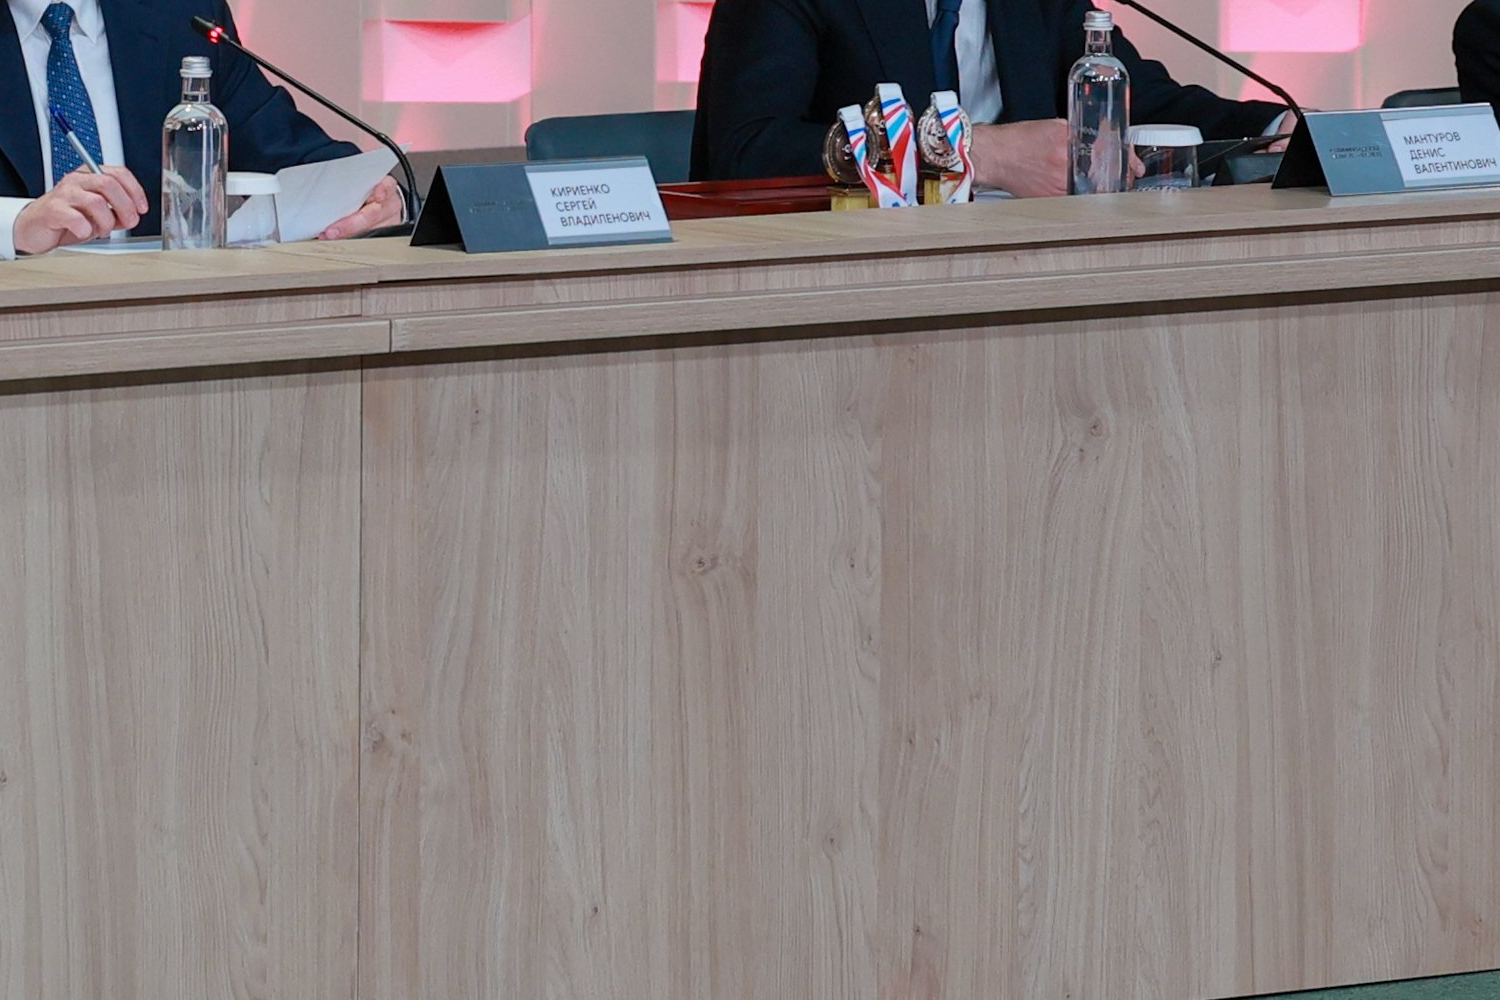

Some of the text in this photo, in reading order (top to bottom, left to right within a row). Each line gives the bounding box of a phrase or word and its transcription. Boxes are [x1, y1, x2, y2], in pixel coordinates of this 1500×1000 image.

[1403, 131, 1461, 146] МАНТУРОВ
[1410, 147, 1446, 161] ДЕНИС
[1414, 158, 1497, 174] ВАЛЕНТИНОВИЧ
[550, 183, 610, 198] КИРИЕНКО
[556, 198, 597, 213] СЕРГЕЙ
[561, 211, 651, 227] ВЛАДИЛЕНОВИЧ
